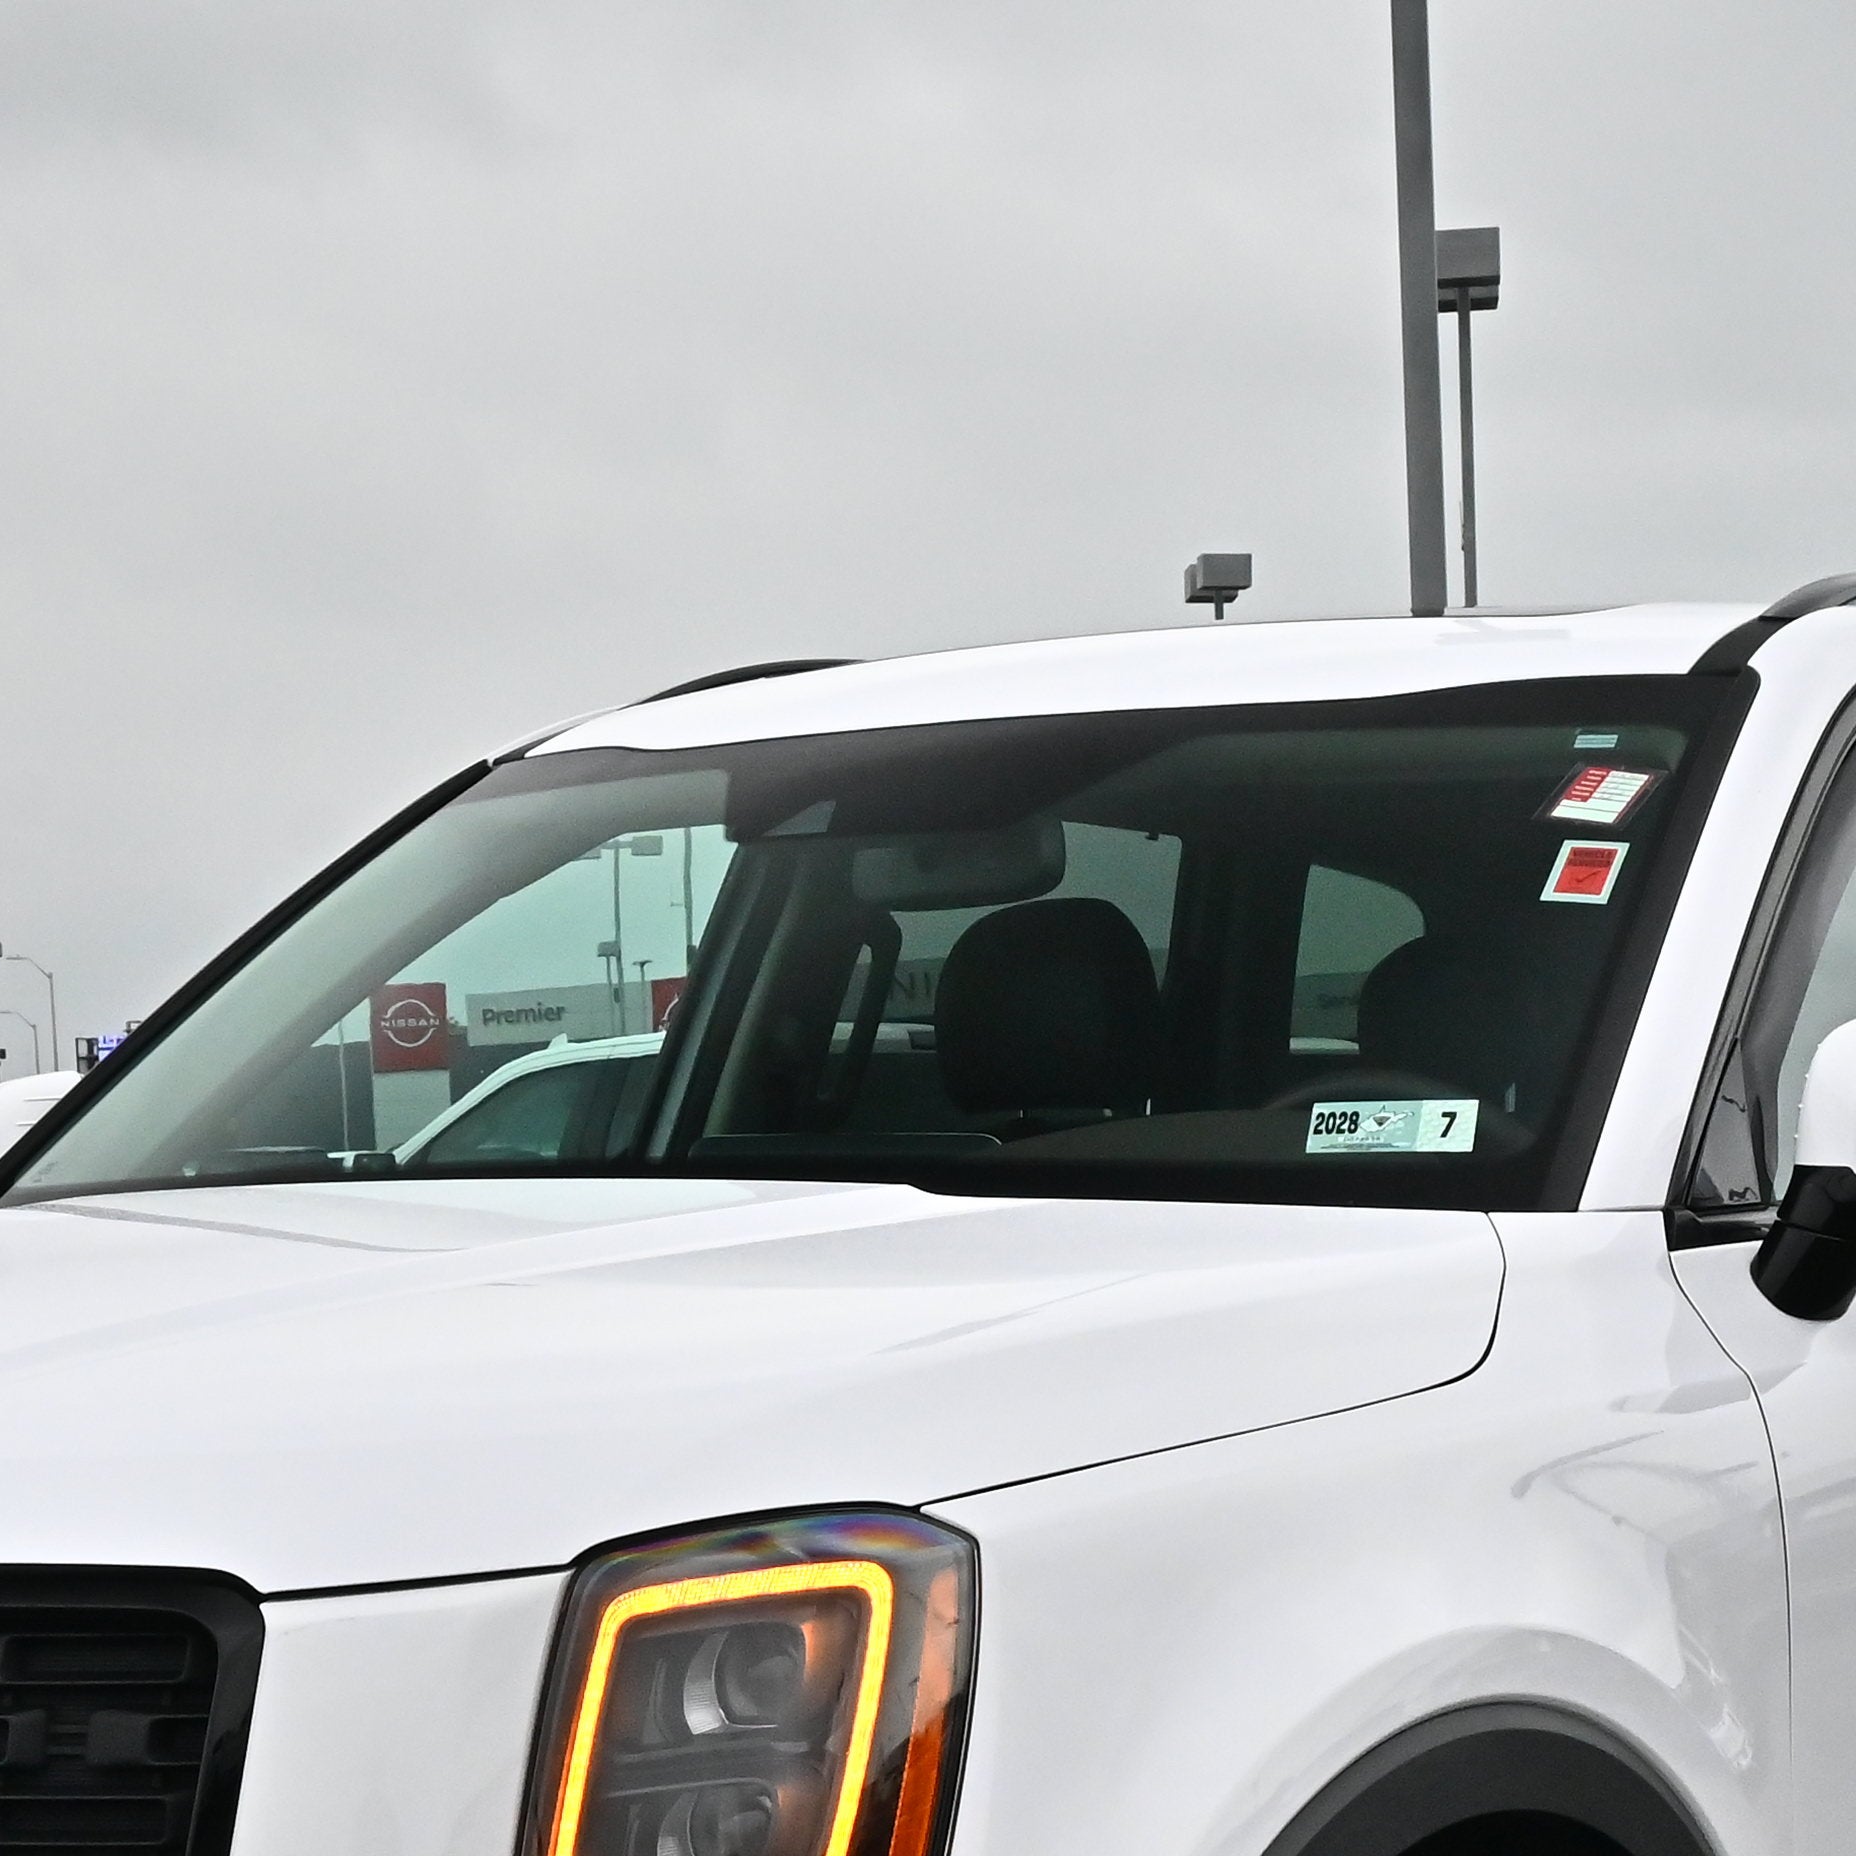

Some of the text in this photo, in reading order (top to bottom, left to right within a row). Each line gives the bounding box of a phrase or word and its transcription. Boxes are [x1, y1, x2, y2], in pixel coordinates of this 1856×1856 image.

[380, 1018, 440, 1028] NISSAN
[482, 1001, 568, 1026] Premier
[1313, 1111, 1360, 1135] 2028
[1440, 1111, 1458, 1138] 7
